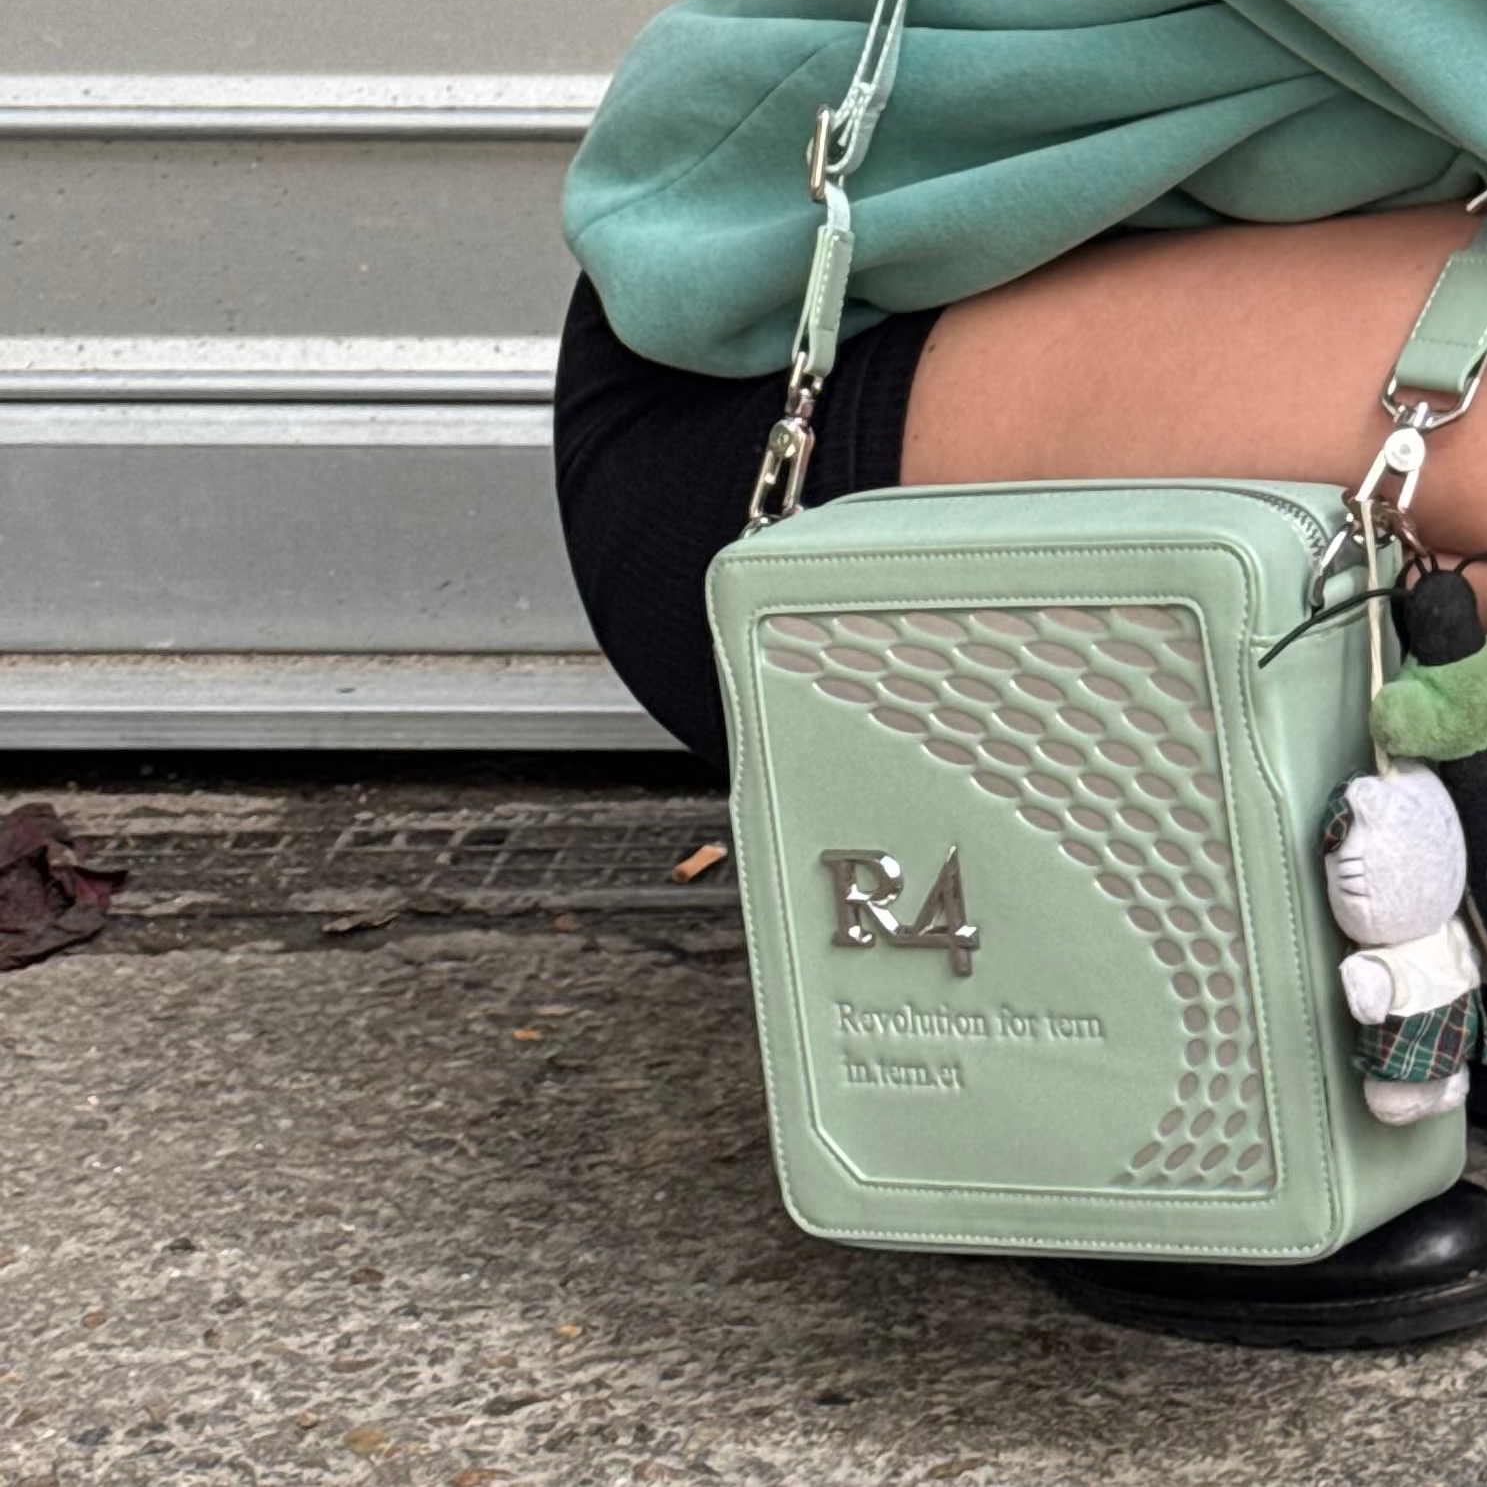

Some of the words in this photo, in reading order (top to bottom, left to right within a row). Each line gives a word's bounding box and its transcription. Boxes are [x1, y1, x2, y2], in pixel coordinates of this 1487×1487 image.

[820, 847, 980, 977] R4
[838, 1002, 987, 1037] Revolution
[997, 1005, 1037, 1038] for
